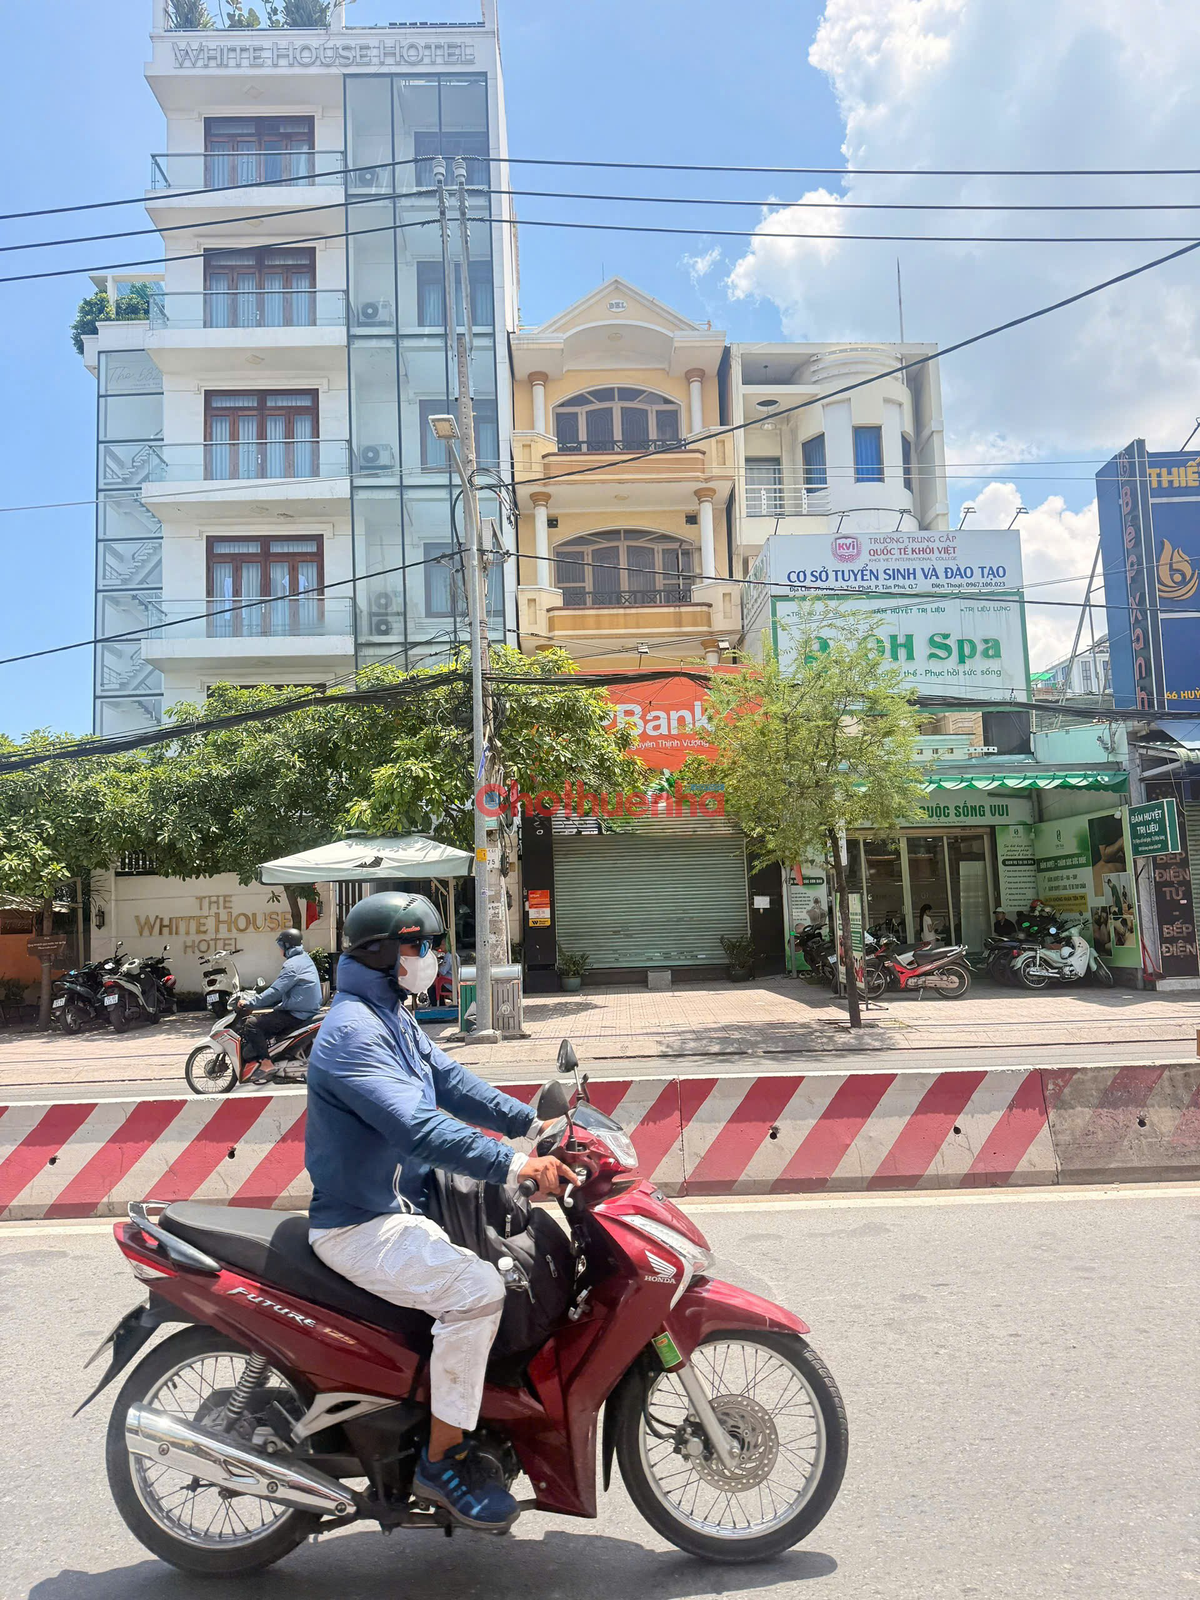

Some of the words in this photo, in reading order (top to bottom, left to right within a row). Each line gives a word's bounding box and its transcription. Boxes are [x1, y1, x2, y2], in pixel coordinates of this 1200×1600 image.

[172, 41, 264, 69] WHITE
[272, 41, 371, 67] HOUSE
[378, 39, 475, 64] HOTEL
[1148, 457, 1200, 488] THIẾ
[869, 535, 905, 545] TRƯỜNG
[907, 536, 936, 544] TRUNG
[938, 533, 957, 543] CẤP
[868, 545, 896, 557] QUỐC
[897, 544, 910, 556] TẾ
[936, 545, 957, 556] VIỆT
[787, 569, 807, 583] CƠ
[810, 566, 829, 583] SỞ
[832, 563, 879, 582] TUYỂN
[883, 568, 917, 581] SINH
[921, 564, 940, 580] VÀ
[944, 564, 974, 580] ĐÀO
[978, 565, 1007, 581] TẠO
[890, 606, 913, 615] HUYỆT
[917, 607, 928, 615] TRỊ
[930, 606, 946, 614] LIỆU
[927, 632, 1002, 665] Spa
[924, 669, 945, 679] Phục
[963, 668, 977, 677] sức
[981, 666, 1002, 677] sống
[658, 739, 680, 749] Thịnh
[682, 738, 710, 748] Vượng
[954, 800, 986, 818] SỐNG
[990, 804, 1009, 817] VUI
[1131, 811, 1144, 824] BẤM
[1144, 808, 1162, 821] HUYỆT
[1137, 825, 1147, 836] TRỊ
[1147, 822, 1159, 835] LIỆU
[1155, 864, 1190, 884] ĐIỆN
[1162, 883, 1185, 900] TỪ
[196, 894, 233, 911] THE
[135, 914, 208, 937] WHITE
[214, 911, 292, 933] HOUSE
[1162, 919, 1192, 938] BẾP
[183, 937, 239, 954] HOTEL
[1161, 940, 1197, 959] ĐIỆN
[644, 1275, 677, 1285] HONDA
[226, 1286, 317, 1328] FUTURE
